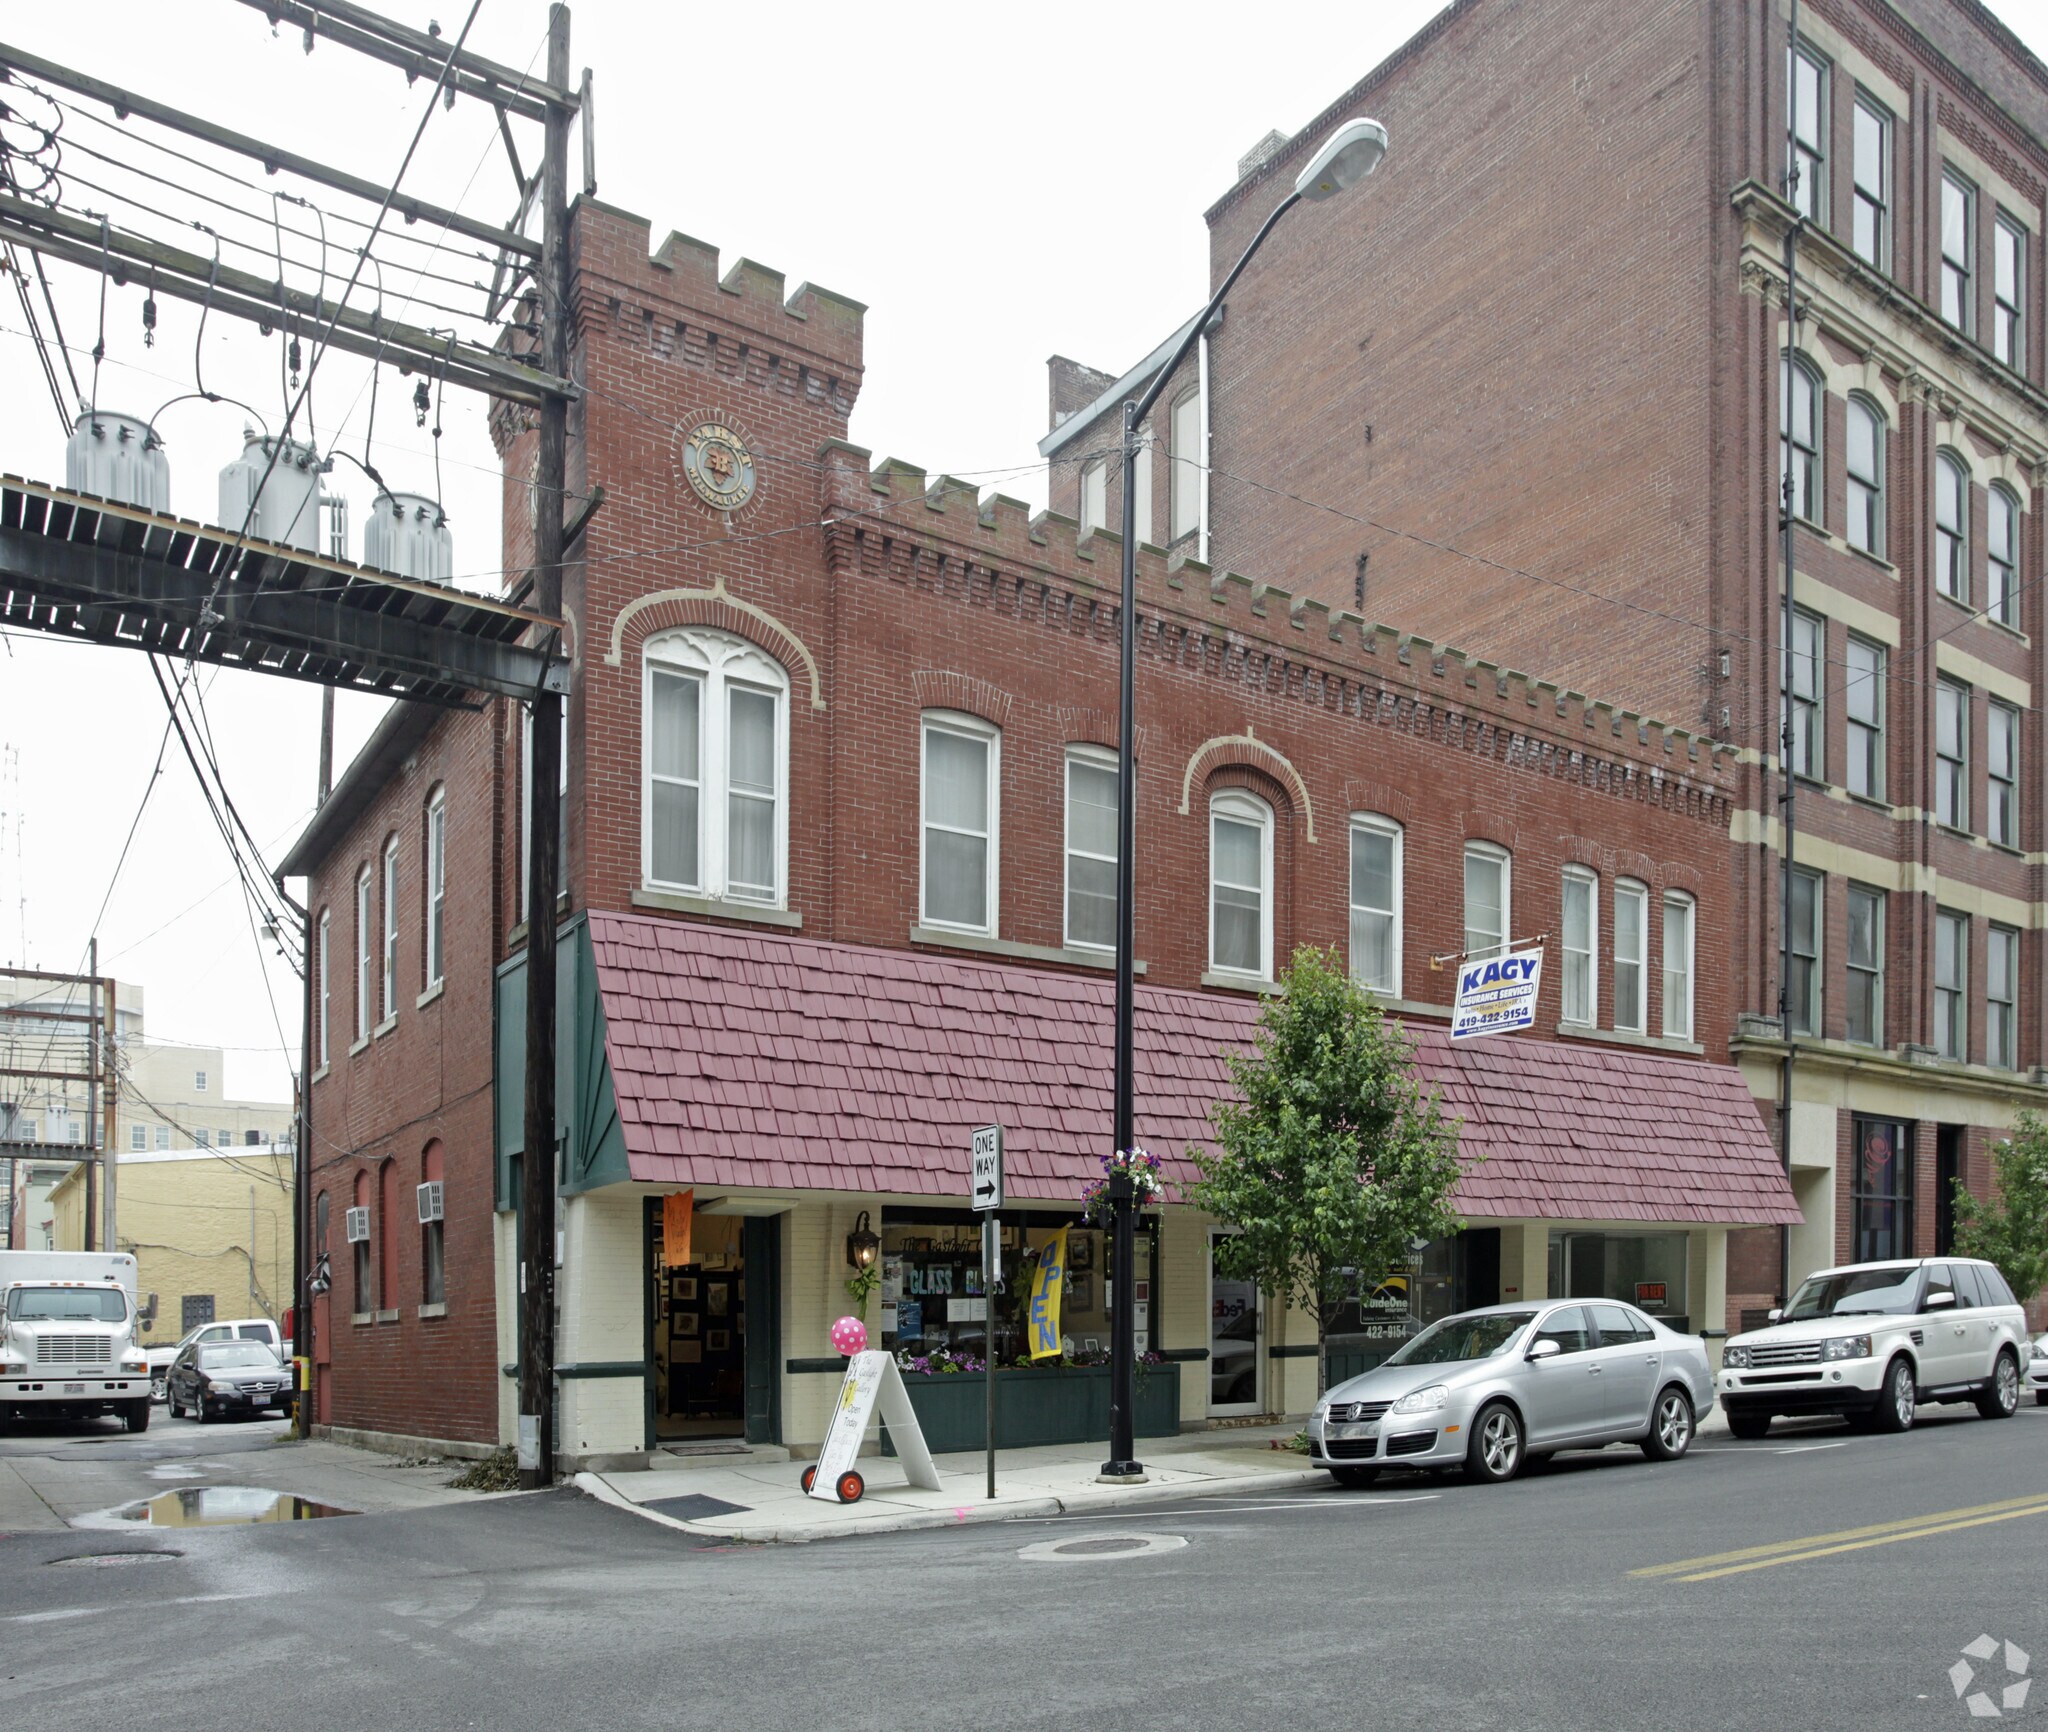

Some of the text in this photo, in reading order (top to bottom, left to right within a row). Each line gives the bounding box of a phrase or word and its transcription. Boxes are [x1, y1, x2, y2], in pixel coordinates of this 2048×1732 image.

[688, 465, 750, 506] MILWAUKEE
[1462, 959, 1537, 995] KAGY
[1460, 984, 1532, 1006] INSURANCE SERVICES
[975, 1134, 994, 1154] ONE
[976, 1156, 995, 1176] WAY
[910, 1269, 952, 1295] GLASS
[1638, 1285, 1665, 1298] FOR RENT
[1031, 1240, 1061, 1351] OPEN
[1366, 1325, 1406, 1339] 422-9154
[847, 1403, 861, 1415] Open
[844, 1417, 859, 1430] Today
